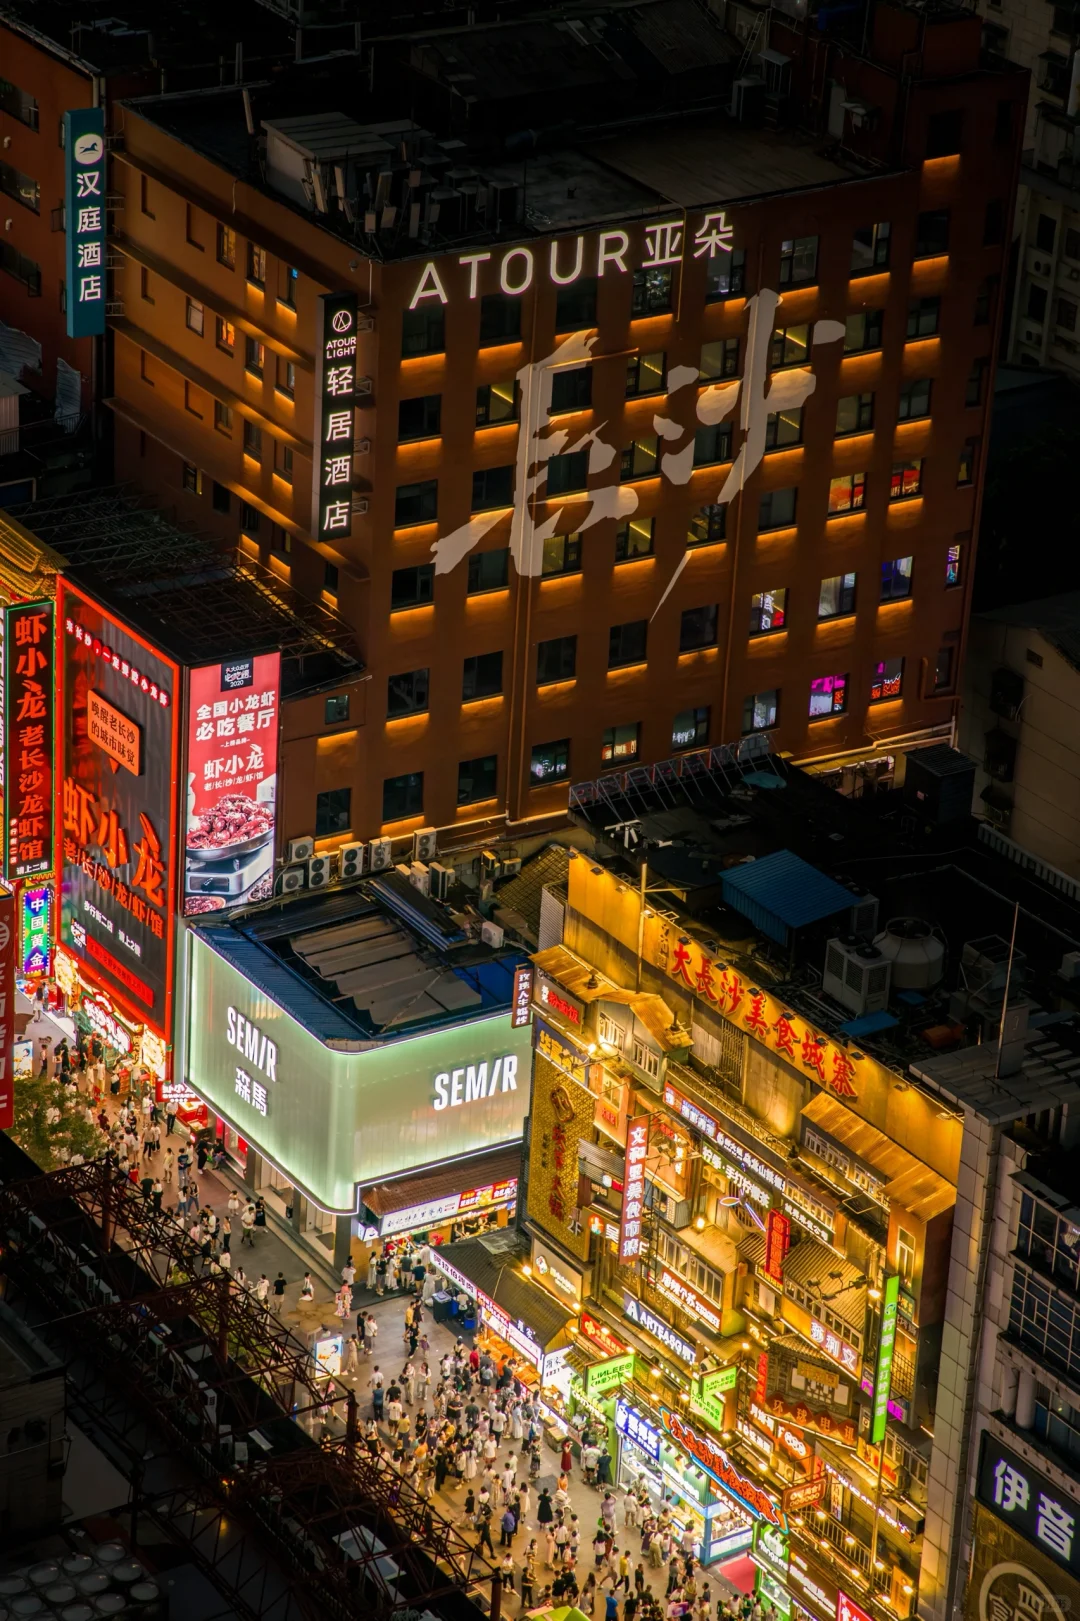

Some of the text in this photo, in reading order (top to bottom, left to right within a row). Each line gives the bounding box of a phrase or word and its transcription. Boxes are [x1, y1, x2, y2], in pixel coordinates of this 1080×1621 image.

[76, 171, 102, 302] 汉庭酒店
[409, 211, 734, 309] ATOUR 亚朵
[325, 335, 357, 350] ATOUR
[325, 345, 357, 359] LIGHT
[323, 365, 354, 530] 轻居酒店
[15, 612, 47, 720] 虾小龙
[229, 679, 244, 688] 2020
[90, 700, 136, 746] 唤醒老长沙
[196, 690, 275, 721] 全国小龙虾
[196, 707, 275, 742] 必吃餐厅
[90, 720, 136, 768] 的城市味觉
[203, 743, 264, 781] 虾小龙
[18, 724, 45, 861] 老长沙龙虾馆
[63, 776, 164, 908] 虾小龙
[30, 896, 44, 967] 中国黄金
[773, 1399, 855, 1442] 环球电讯
